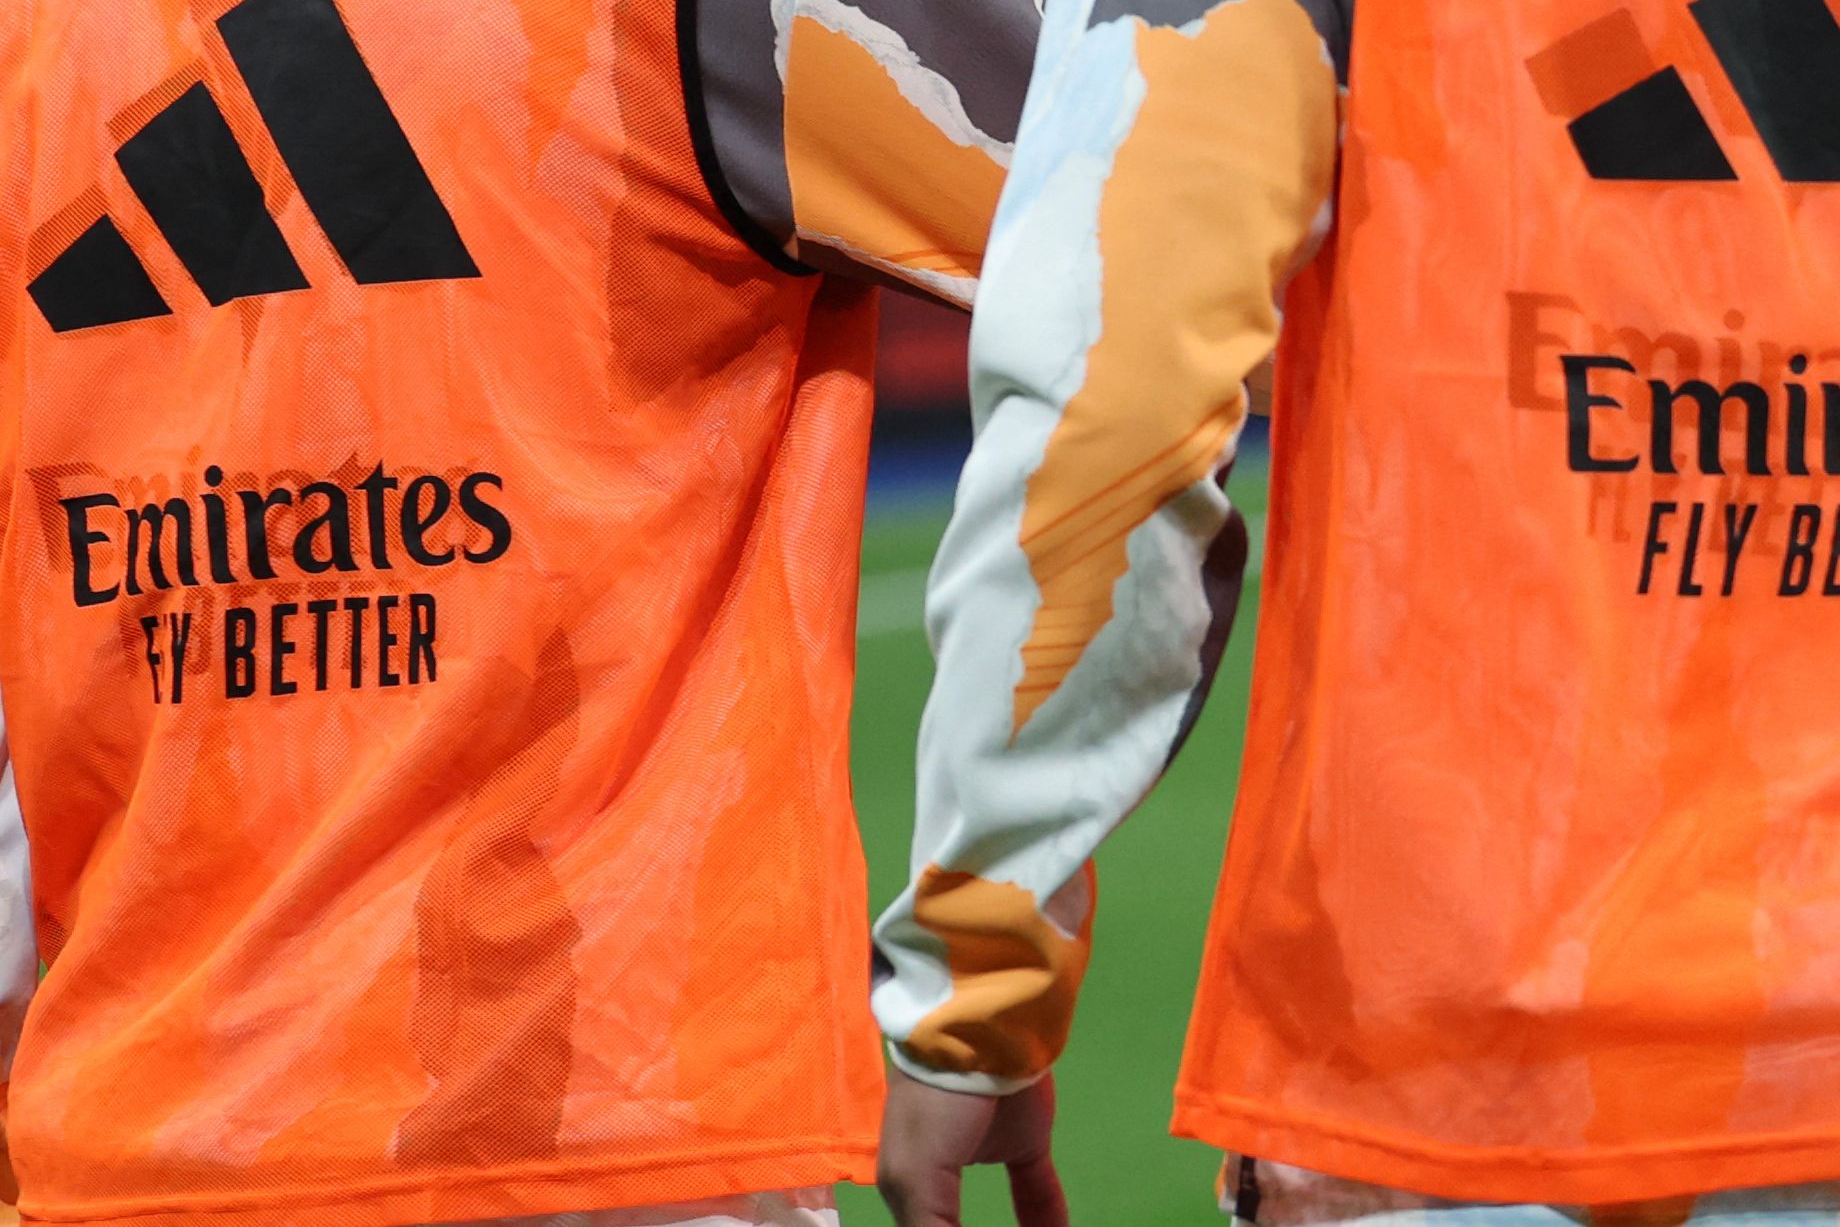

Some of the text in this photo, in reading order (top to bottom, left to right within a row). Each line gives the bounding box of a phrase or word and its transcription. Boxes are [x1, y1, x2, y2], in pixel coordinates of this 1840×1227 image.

[58, 459, 512, 607] Emirates
[1638, 502, 1758, 597] FLY
[224, 593, 437, 699] BETTER
